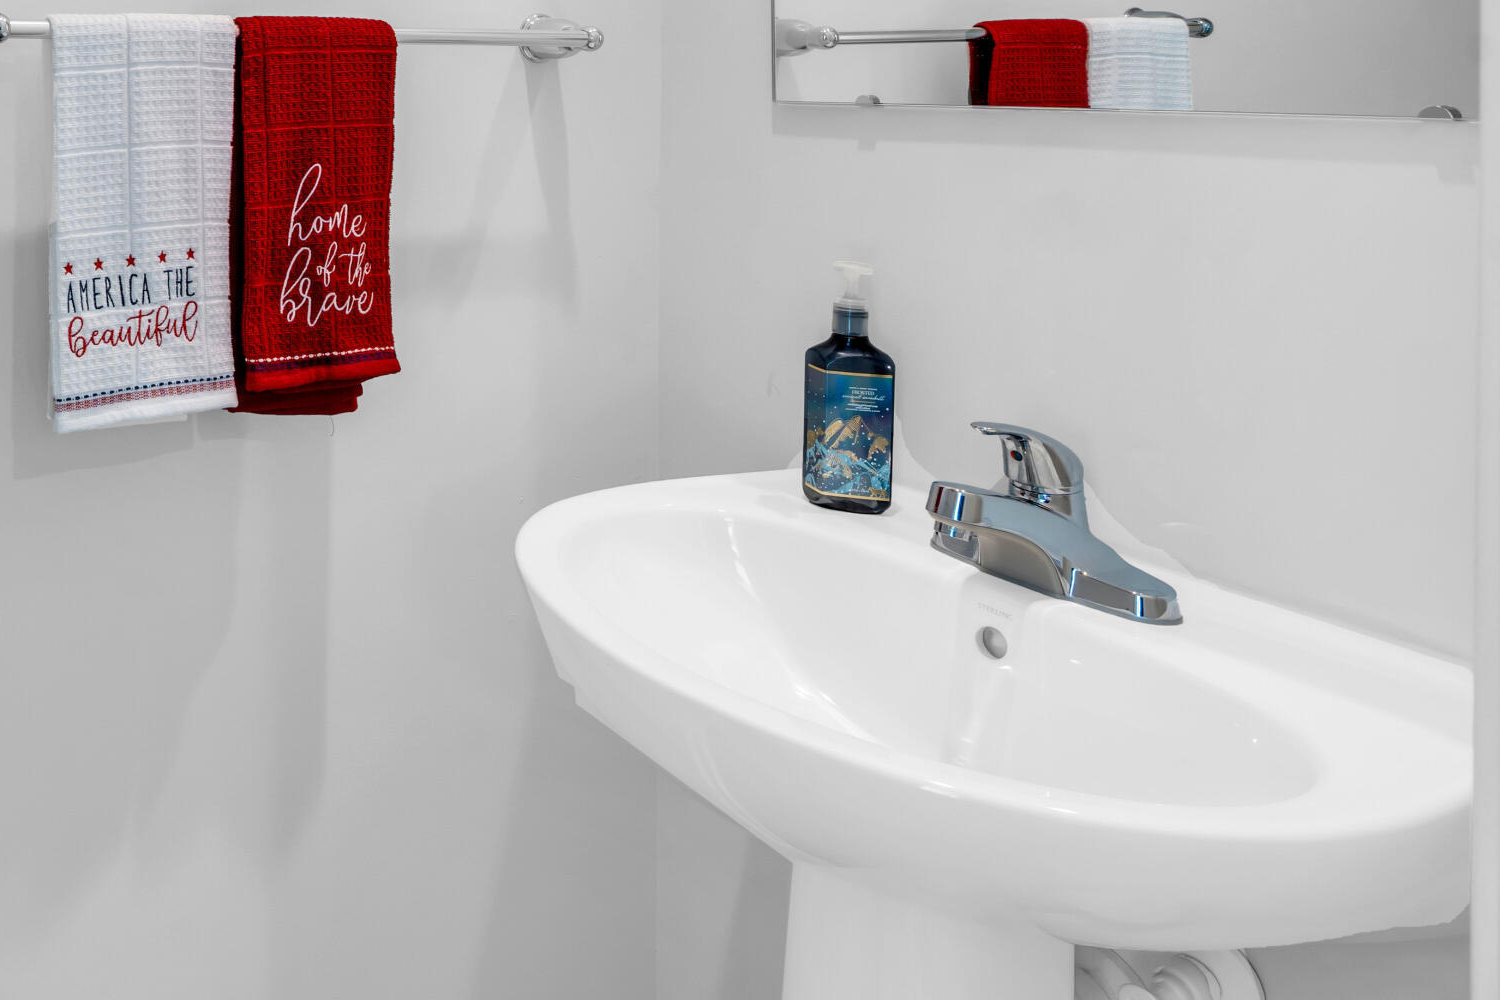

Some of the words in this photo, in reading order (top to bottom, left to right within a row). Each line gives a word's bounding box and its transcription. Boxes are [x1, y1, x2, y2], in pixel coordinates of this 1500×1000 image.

[287, 163, 367, 247] home
[67, 273, 151, 313] AMERICA
[163, 266, 196, 301] THE
[280, 247, 374, 327] brave
[316, 241, 338, 287] of
[338, 242, 371, 287] the
[67, 300, 198, 357] beautiful
